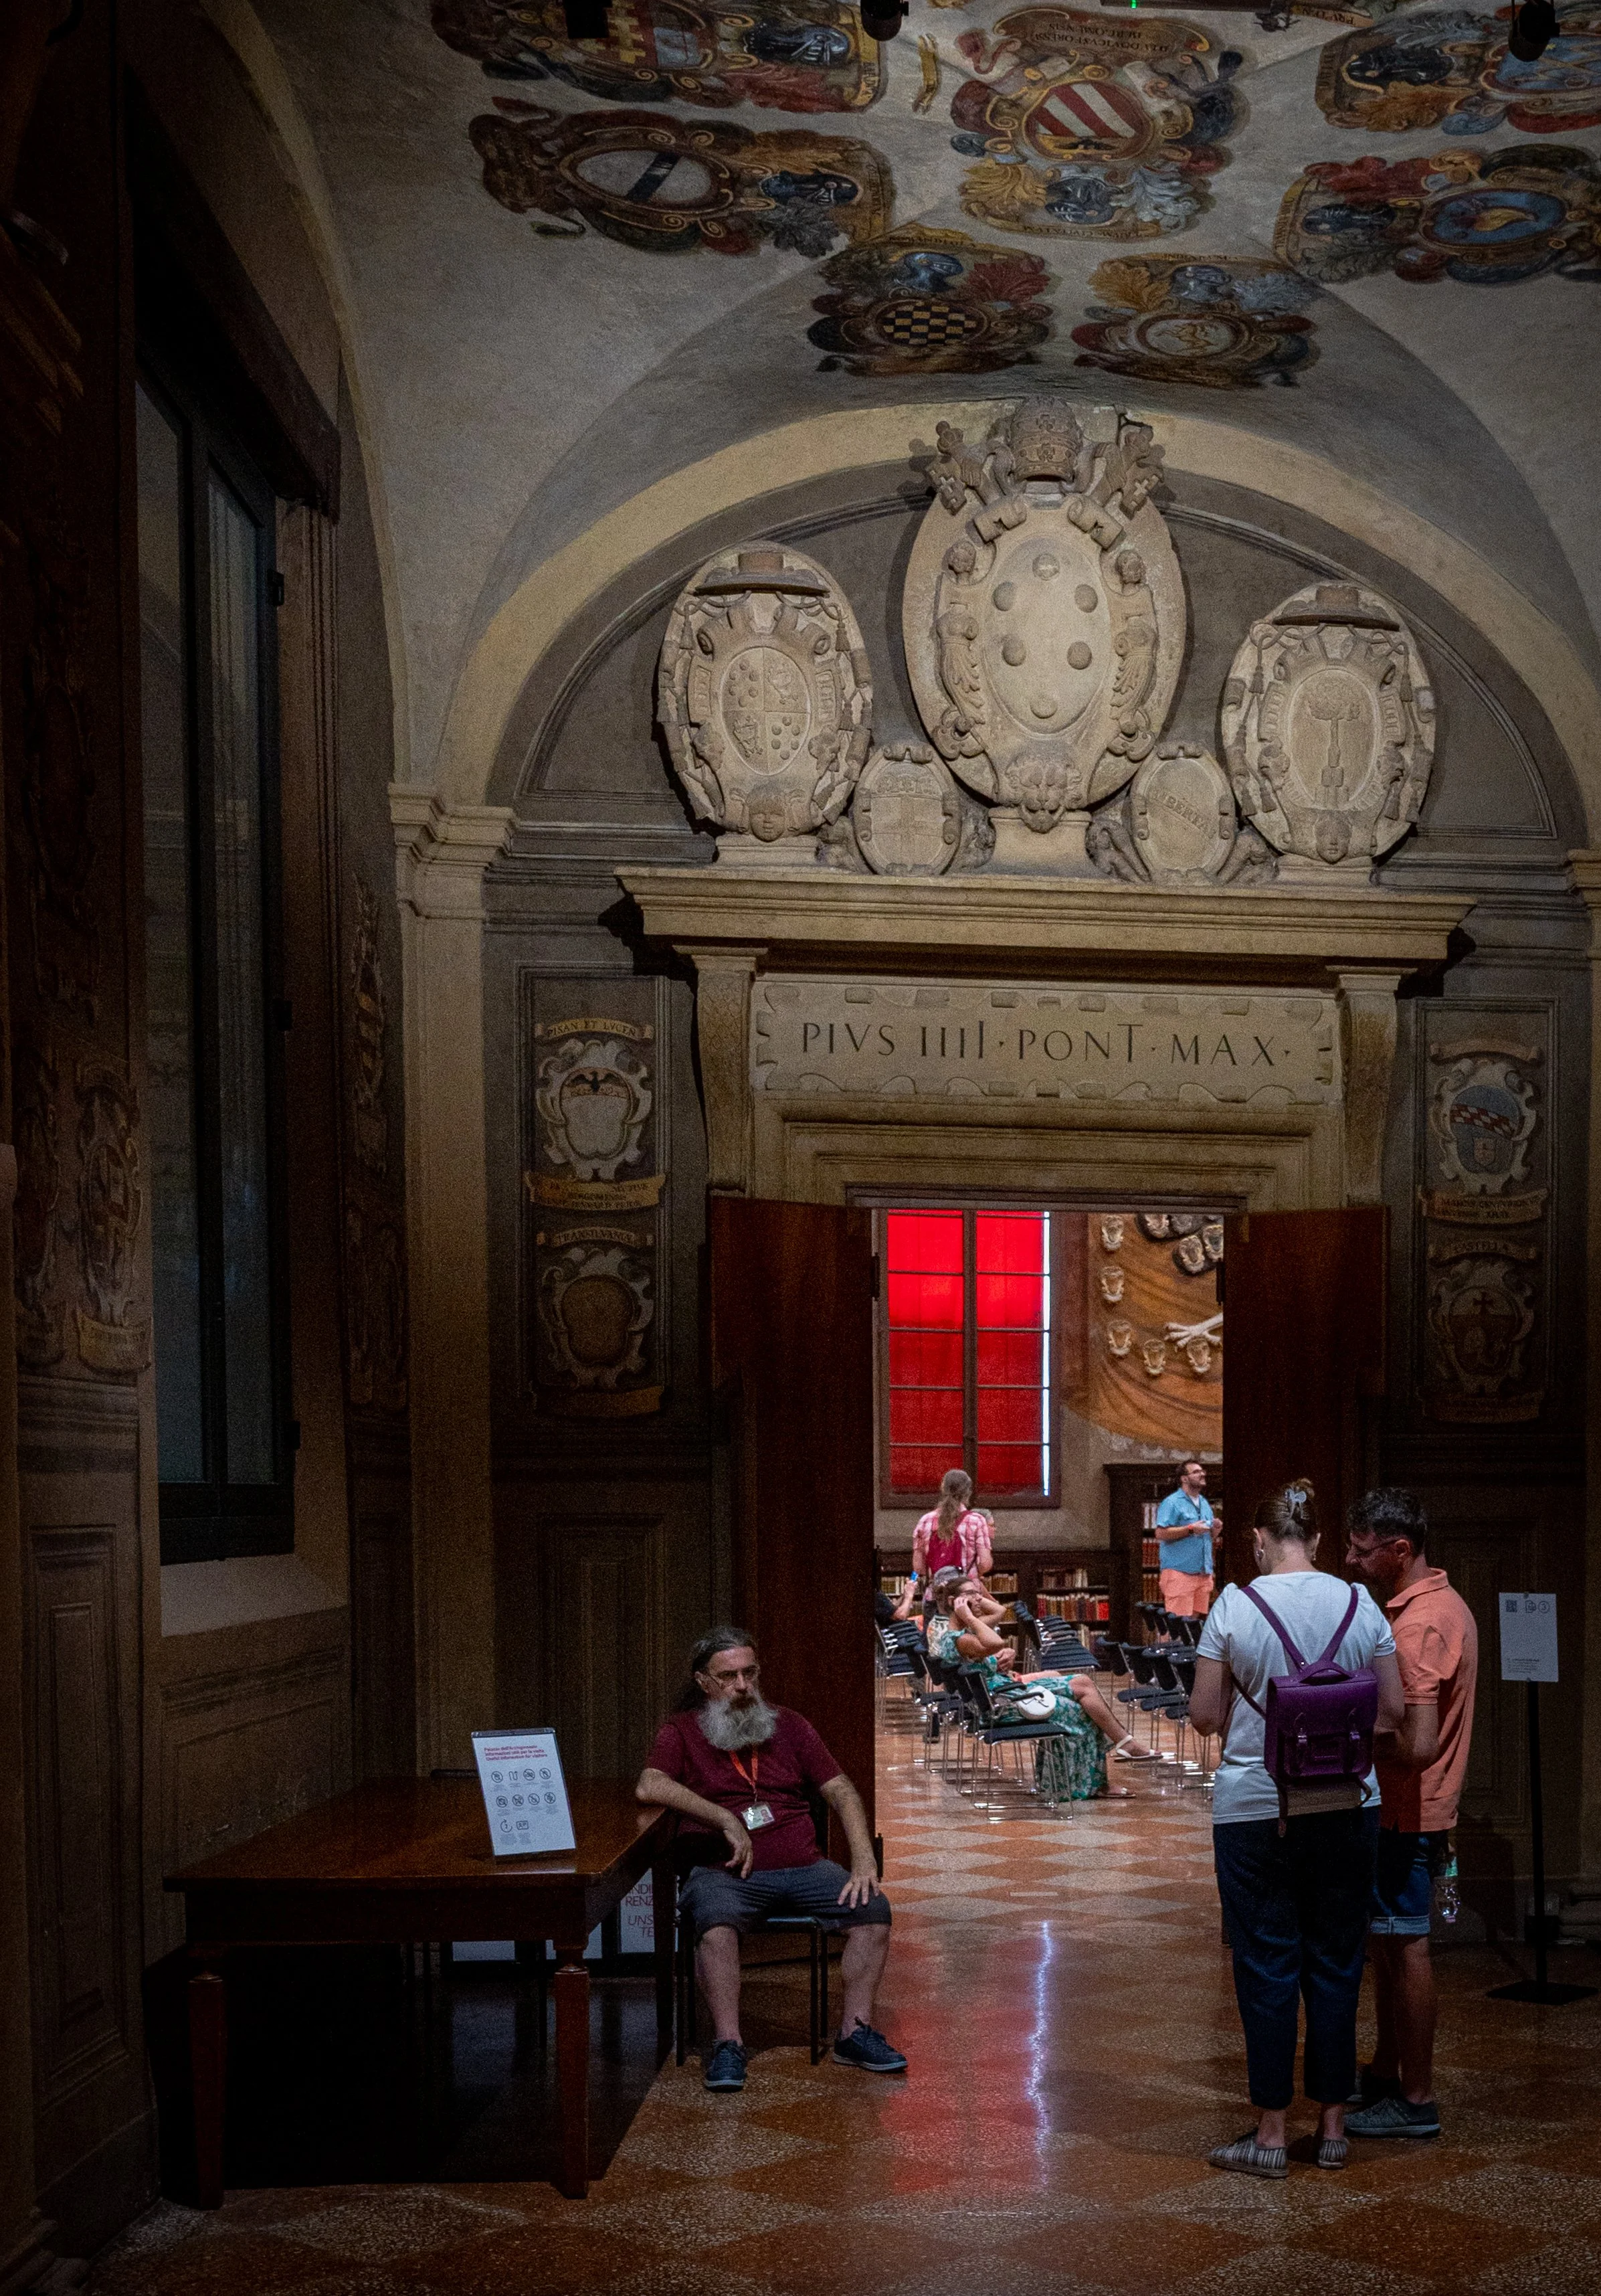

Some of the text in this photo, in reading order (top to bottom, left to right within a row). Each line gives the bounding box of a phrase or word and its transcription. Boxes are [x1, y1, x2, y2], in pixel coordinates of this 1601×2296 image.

[584, 1020, 598, 1029] ET
[802, 1021, 897, 1057] PIVS
[628, 1884, 653, 1894] NDI
